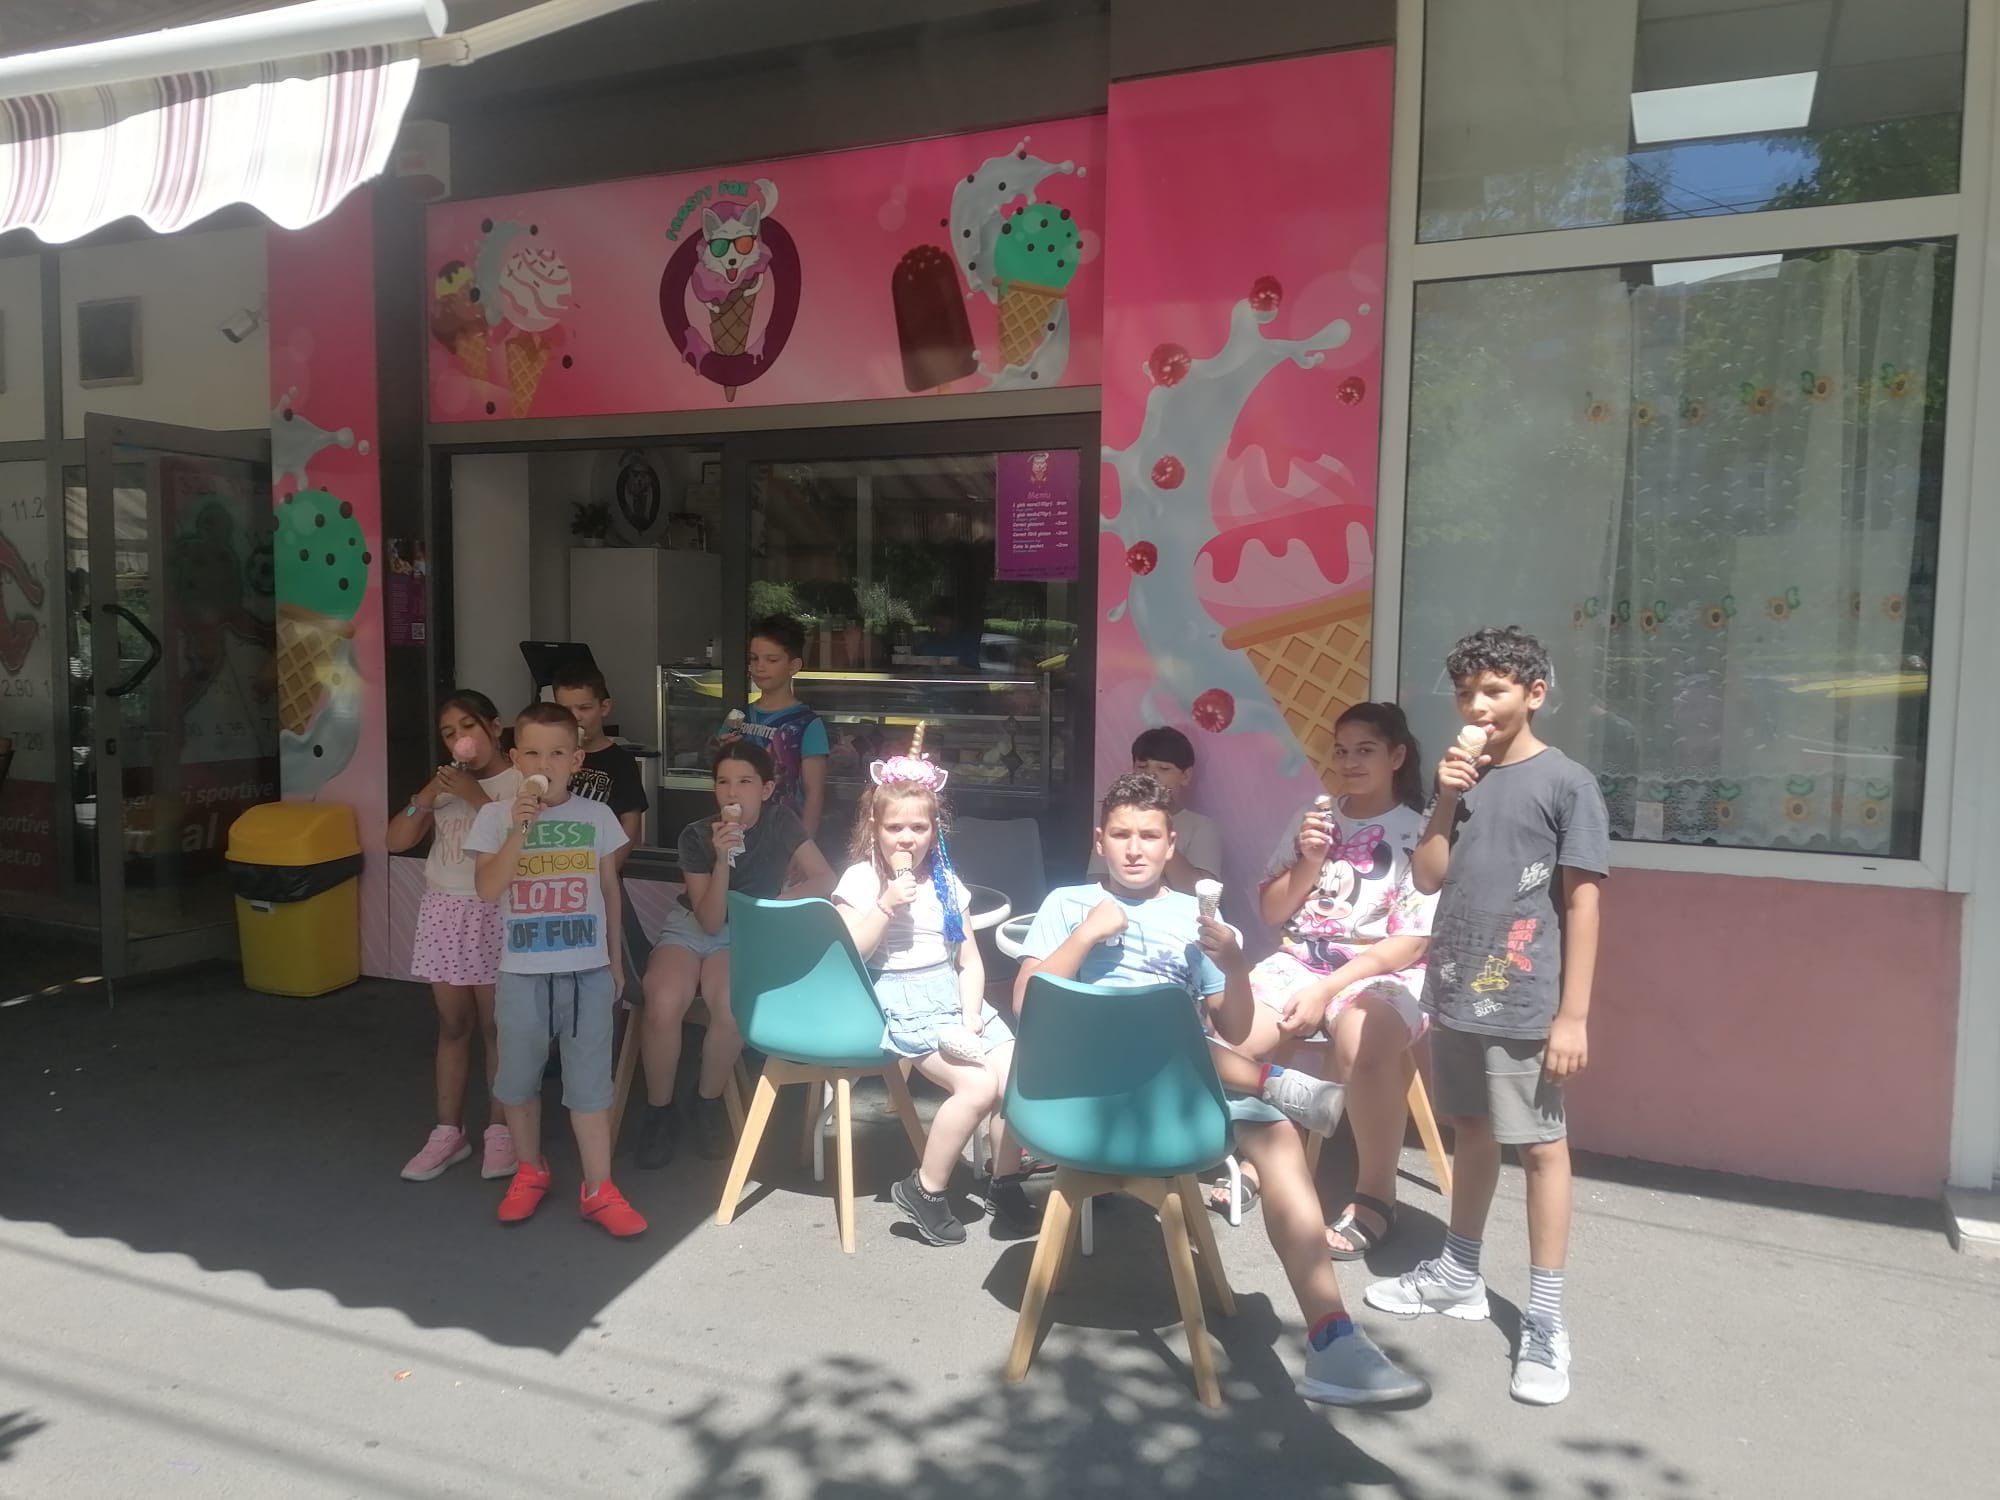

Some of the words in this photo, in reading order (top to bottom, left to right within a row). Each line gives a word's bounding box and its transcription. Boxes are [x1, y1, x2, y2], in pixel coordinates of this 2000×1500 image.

[719, 182, 747, 196] FOX
[524, 823, 581, 847] LESS
[515, 851, 595, 877] SCHOOL
[511, 881, 584, 911] LOTS
[512, 922, 539, 949] OF
[545, 918, 593, 947] FUN
